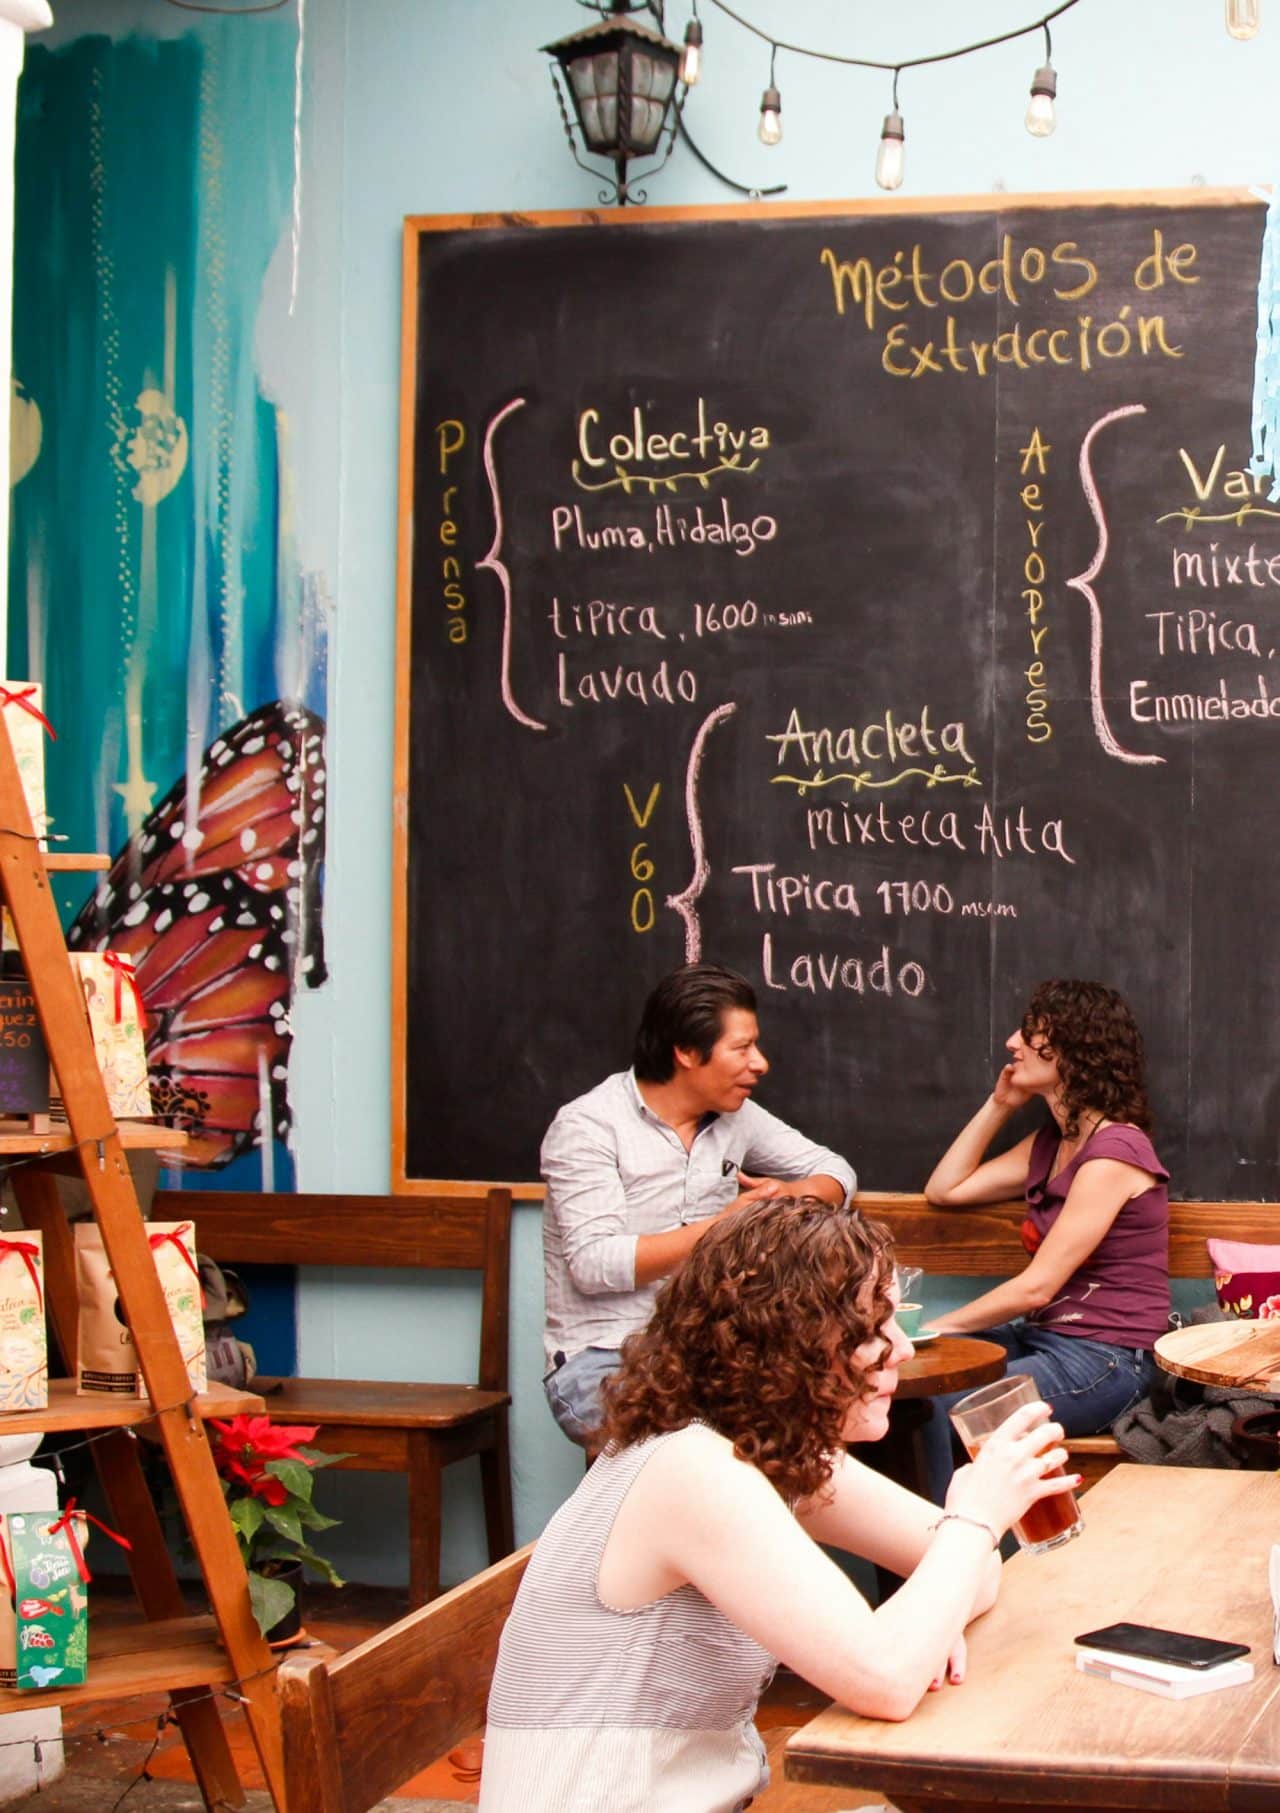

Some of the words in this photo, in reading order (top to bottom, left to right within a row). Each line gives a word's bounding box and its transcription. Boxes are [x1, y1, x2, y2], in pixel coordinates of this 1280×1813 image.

[820, 233, 1098, 330] Métodos
[1134, 229, 1200, 291] de
[881, 305, 1184, 378] Extracción
[578, 398, 770, 467] Colectiva
[435, 419, 467, 644] Prensa
[656, 497, 777, 556] Hidalgo
[694, 600, 757, 637] 1600
[558, 652, 696, 707] Lavado
[766, 705, 976, 765] Anacleta
[974, 802, 1076, 864] Alta
[876, 879, 954, 915] 1700
[761, 932, 925, 996] Lavado
